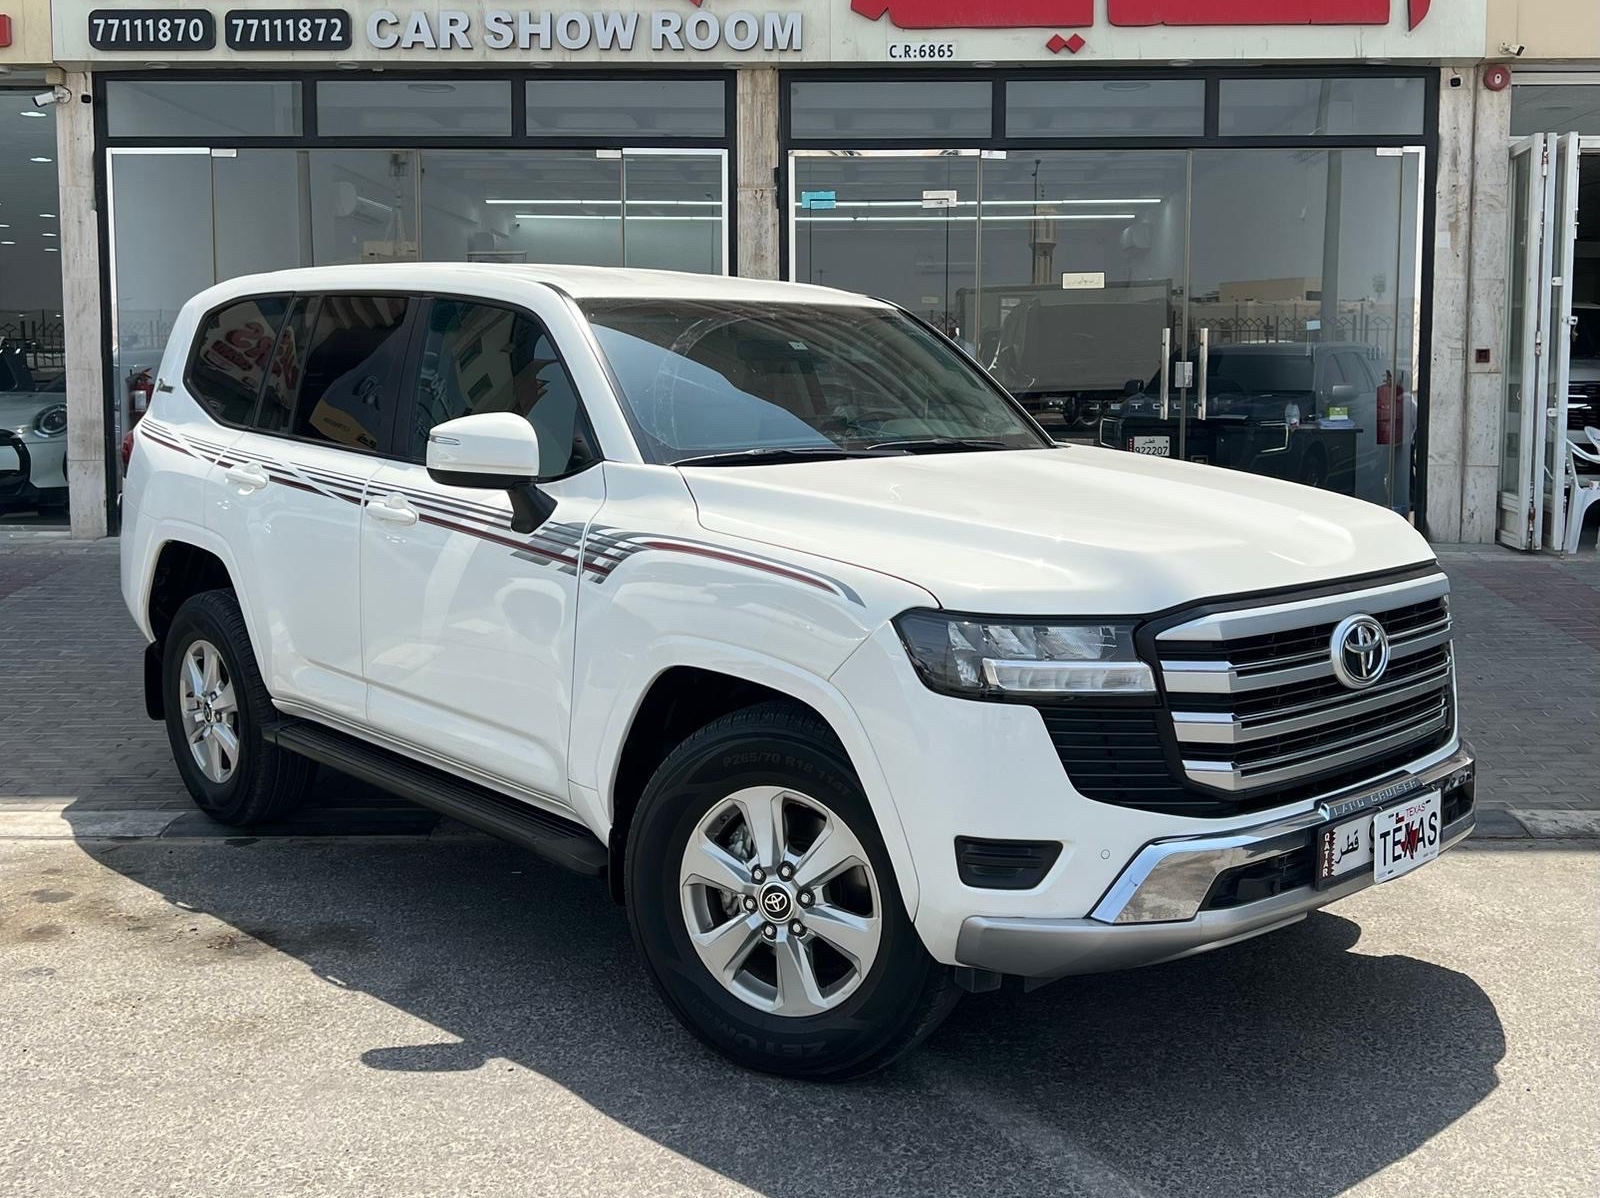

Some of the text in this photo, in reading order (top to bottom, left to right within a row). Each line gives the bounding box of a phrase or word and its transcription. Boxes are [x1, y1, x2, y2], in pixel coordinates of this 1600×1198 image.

[93, 18, 204, 42] 77111870
[231, 18, 343, 42] 77111872
[366, 10, 803, 51] CAR SHOW ROOM
[889, 44, 954, 58] C.R:6865
[1333, 781, 1416, 815] LAND CRUISER
[1406, 803, 1426, 817] TEXAS
[1322, 833, 1331, 877] QATAR
[1335, 829, 1360, 864] قطر
[1380, 811, 1438, 866] TEXAS
